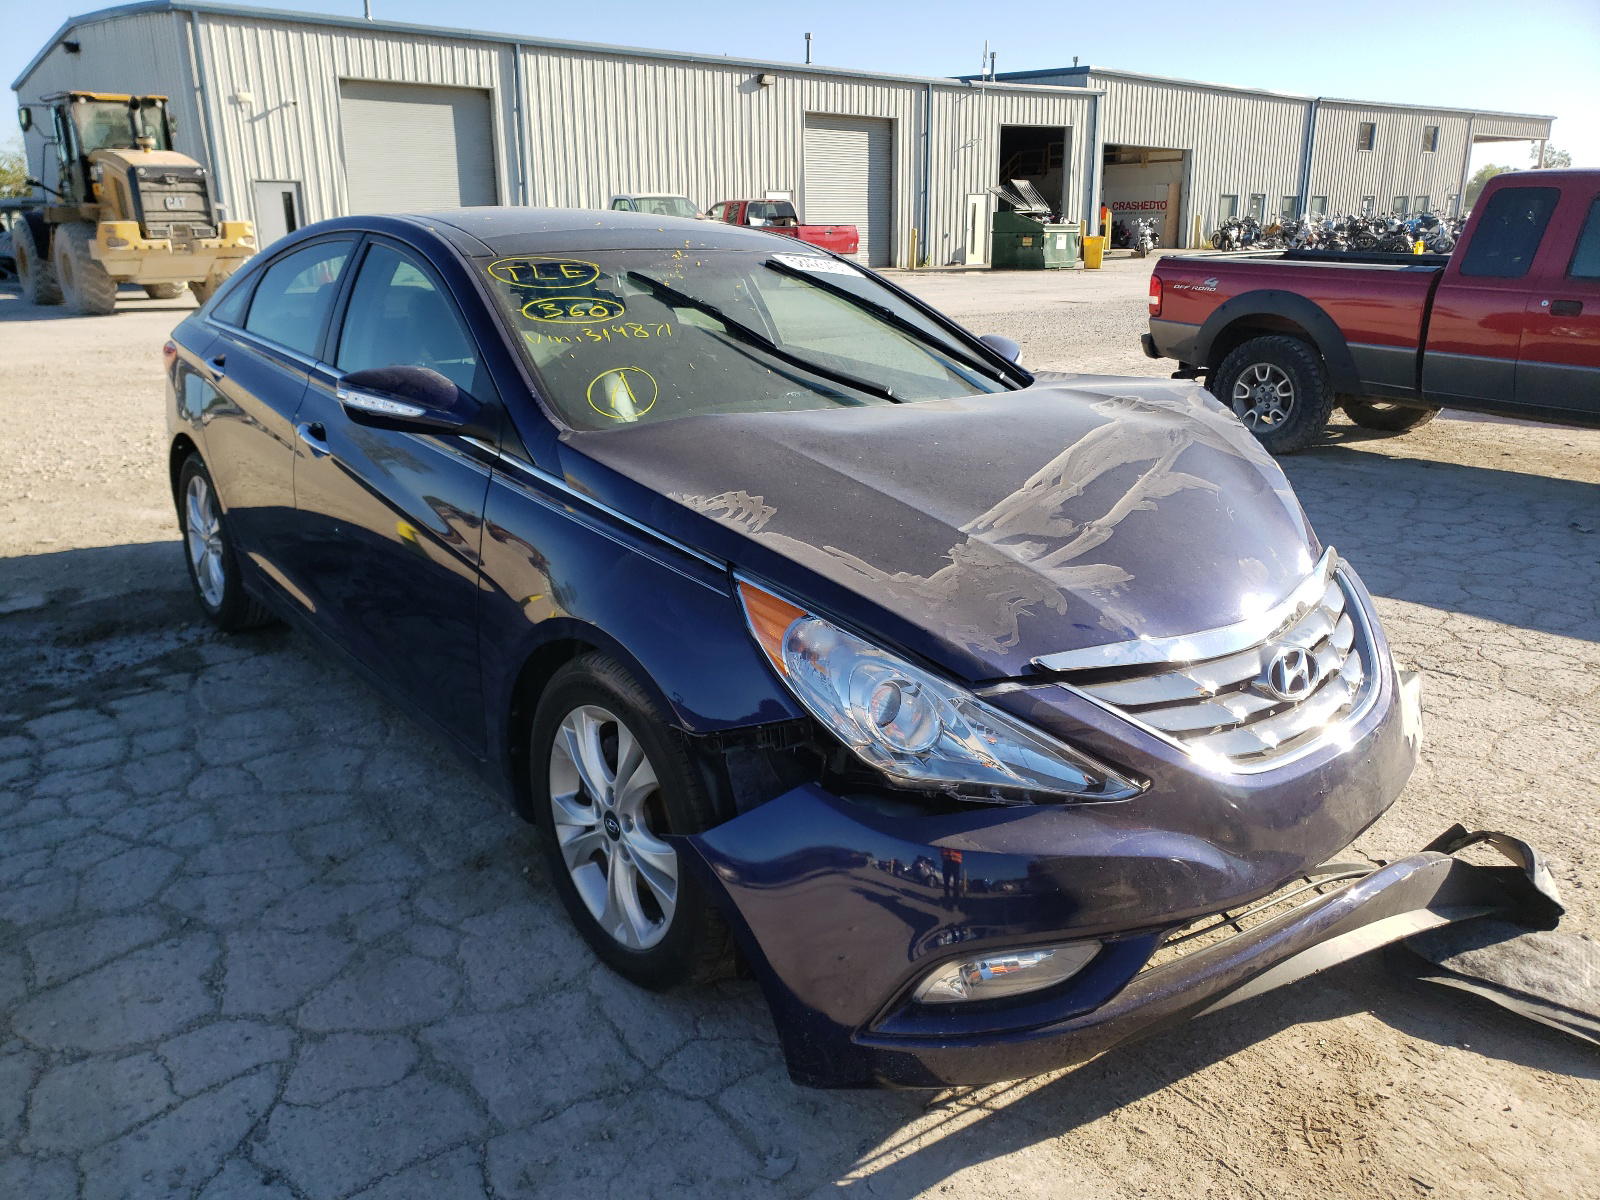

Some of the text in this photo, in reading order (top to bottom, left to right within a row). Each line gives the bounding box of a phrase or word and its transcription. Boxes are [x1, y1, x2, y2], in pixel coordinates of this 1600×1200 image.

[1112, 199, 1168, 211] CRASHEDTO
[497, 264, 588, 282] TLE
[537, 303, 608, 319] 360
